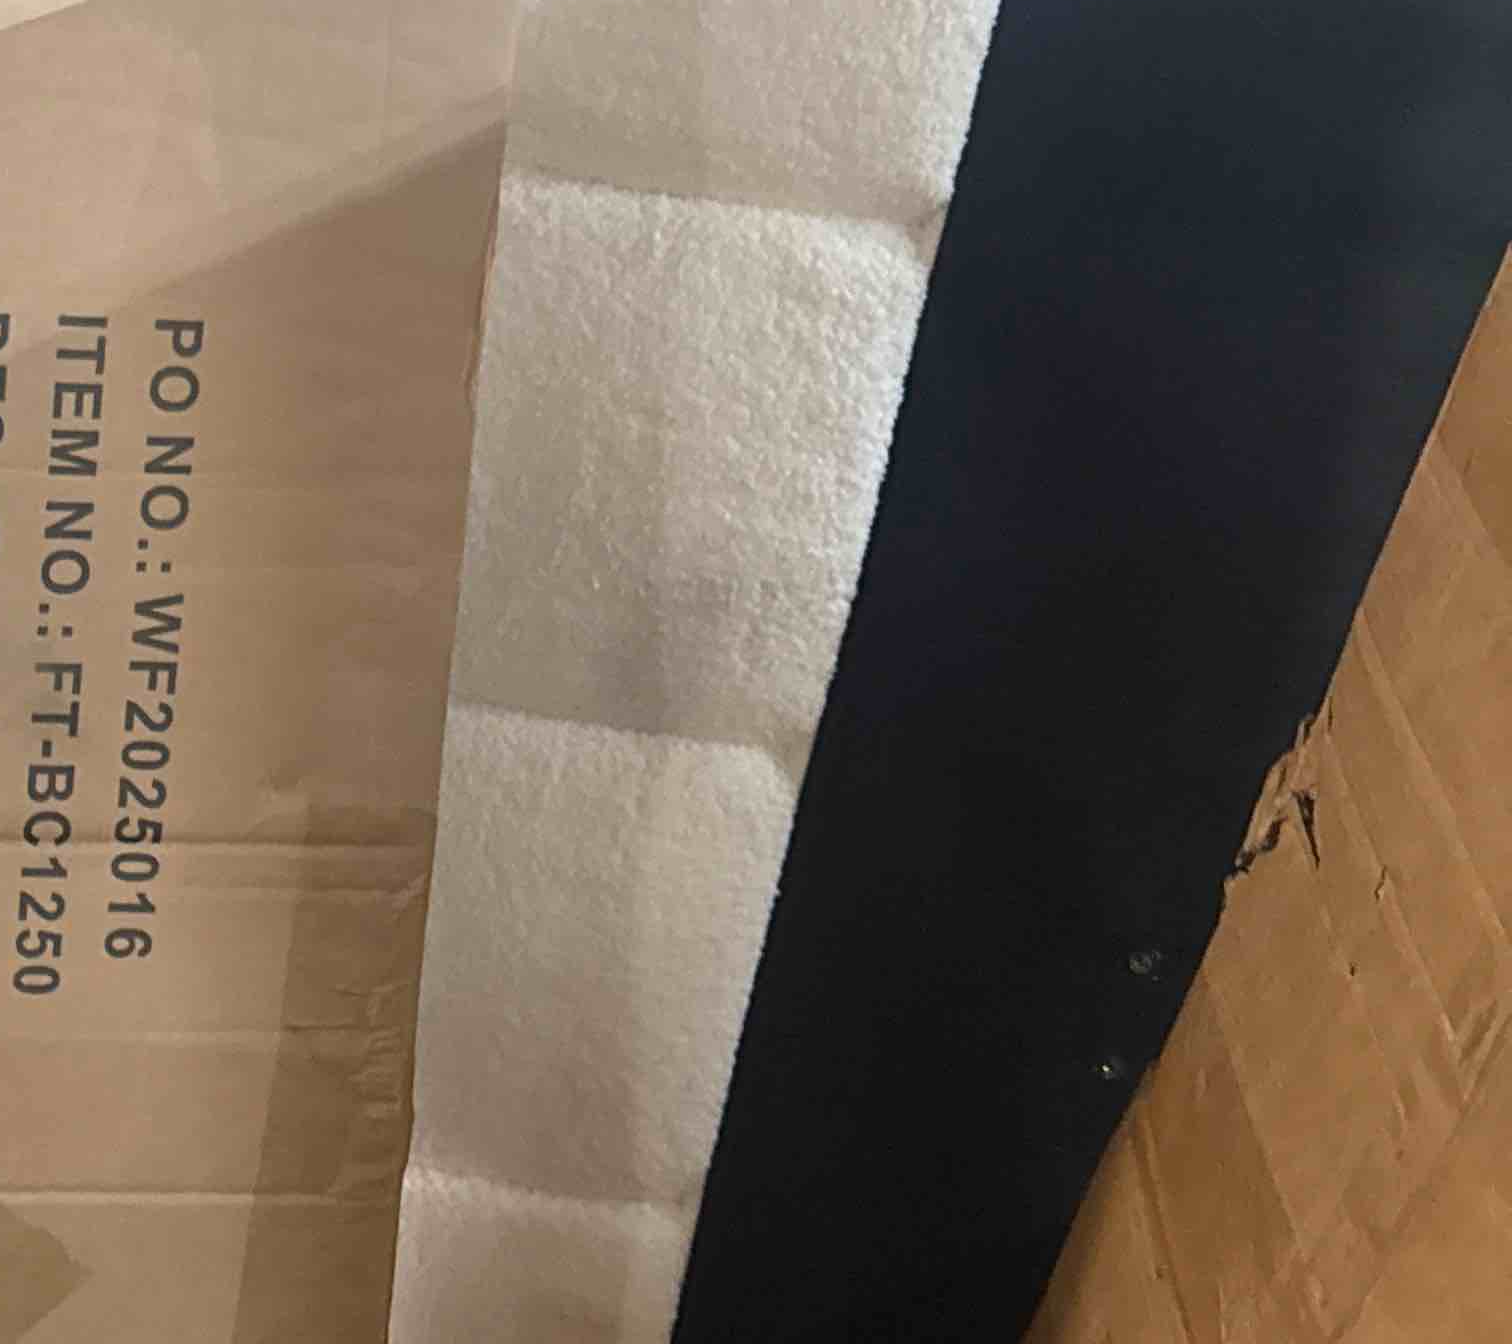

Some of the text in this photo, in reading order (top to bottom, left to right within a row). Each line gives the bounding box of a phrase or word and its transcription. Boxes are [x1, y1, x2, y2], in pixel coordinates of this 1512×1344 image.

[13, 314, 109, 995] ITEM NO.: FT-BC1250
[105, 320, 205, 959] PO NO.: WF2025016
